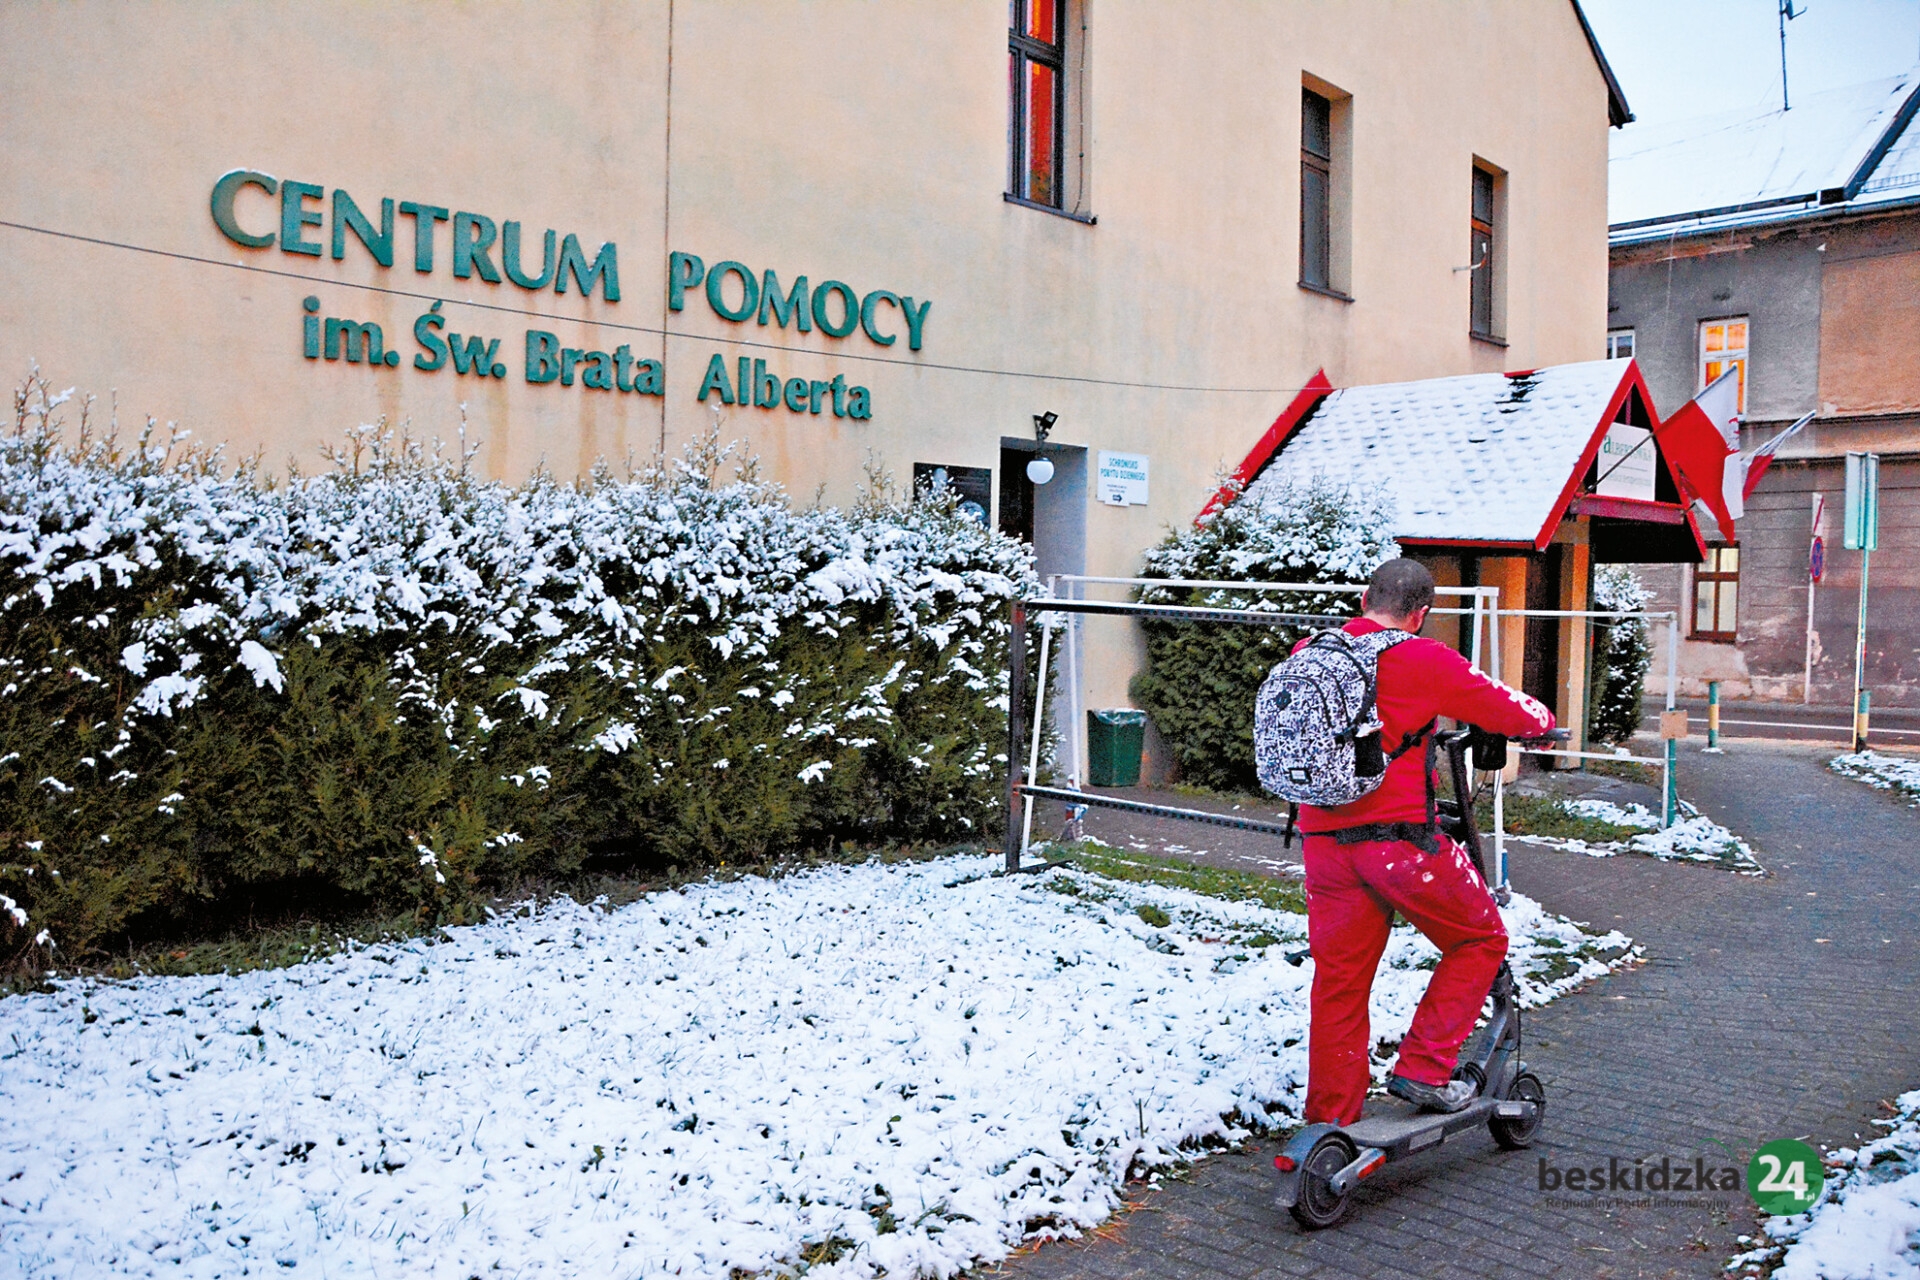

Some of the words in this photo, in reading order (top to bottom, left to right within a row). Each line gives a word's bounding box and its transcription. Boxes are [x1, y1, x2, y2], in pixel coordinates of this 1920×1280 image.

[211, 168, 621, 302] CENTRUM
[669, 250, 932, 351] POMOCY
[303, 295, 400, 367] im.
[414, 299, 507, 379] Św.
[526, 329, 665, 395] Brata
[697, 353, 872, 420] Alberta
[1100, 468, 1119, 478] POBYTU
[1109, 458, 1138, 469] SCHRONISKO
